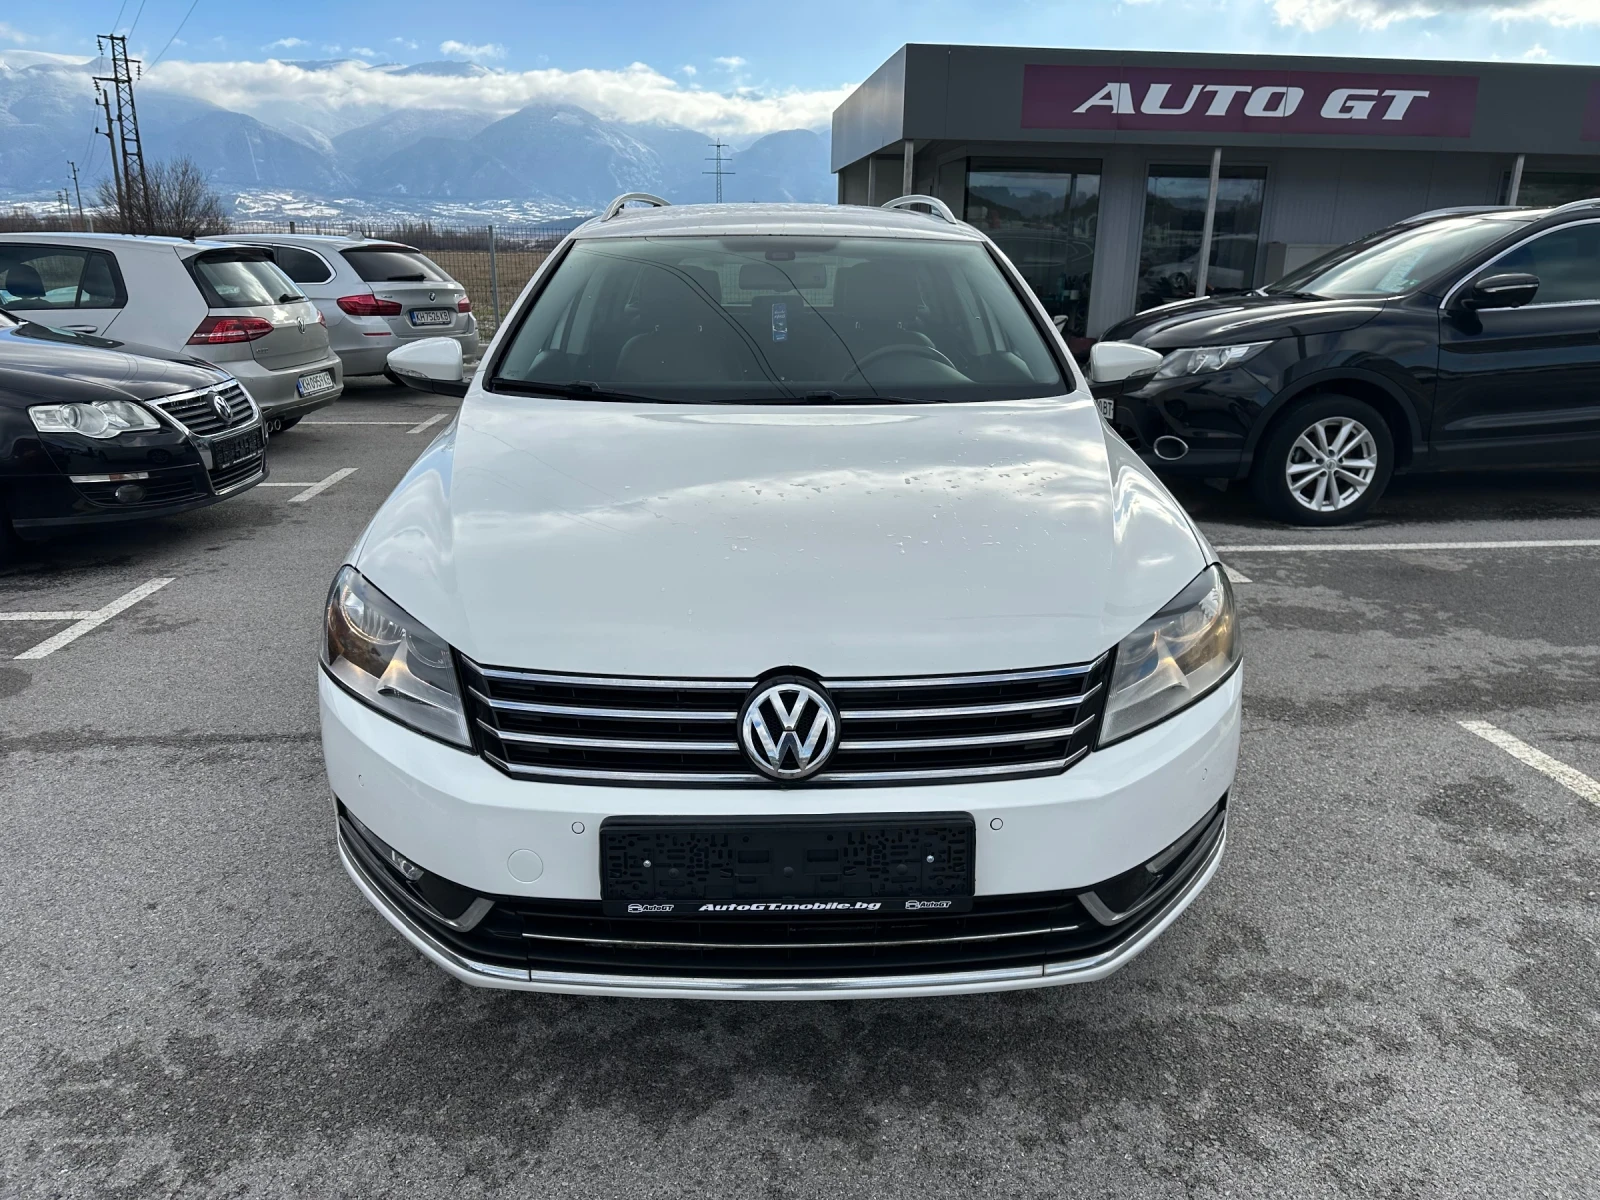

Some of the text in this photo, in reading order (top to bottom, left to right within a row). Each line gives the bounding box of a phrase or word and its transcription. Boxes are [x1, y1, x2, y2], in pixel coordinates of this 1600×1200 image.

[1072, 82, 1430, 121] AUTO GT
[642, 904, 675, 912] AutoGT
[920, 901, 952, 909] AutoGT
